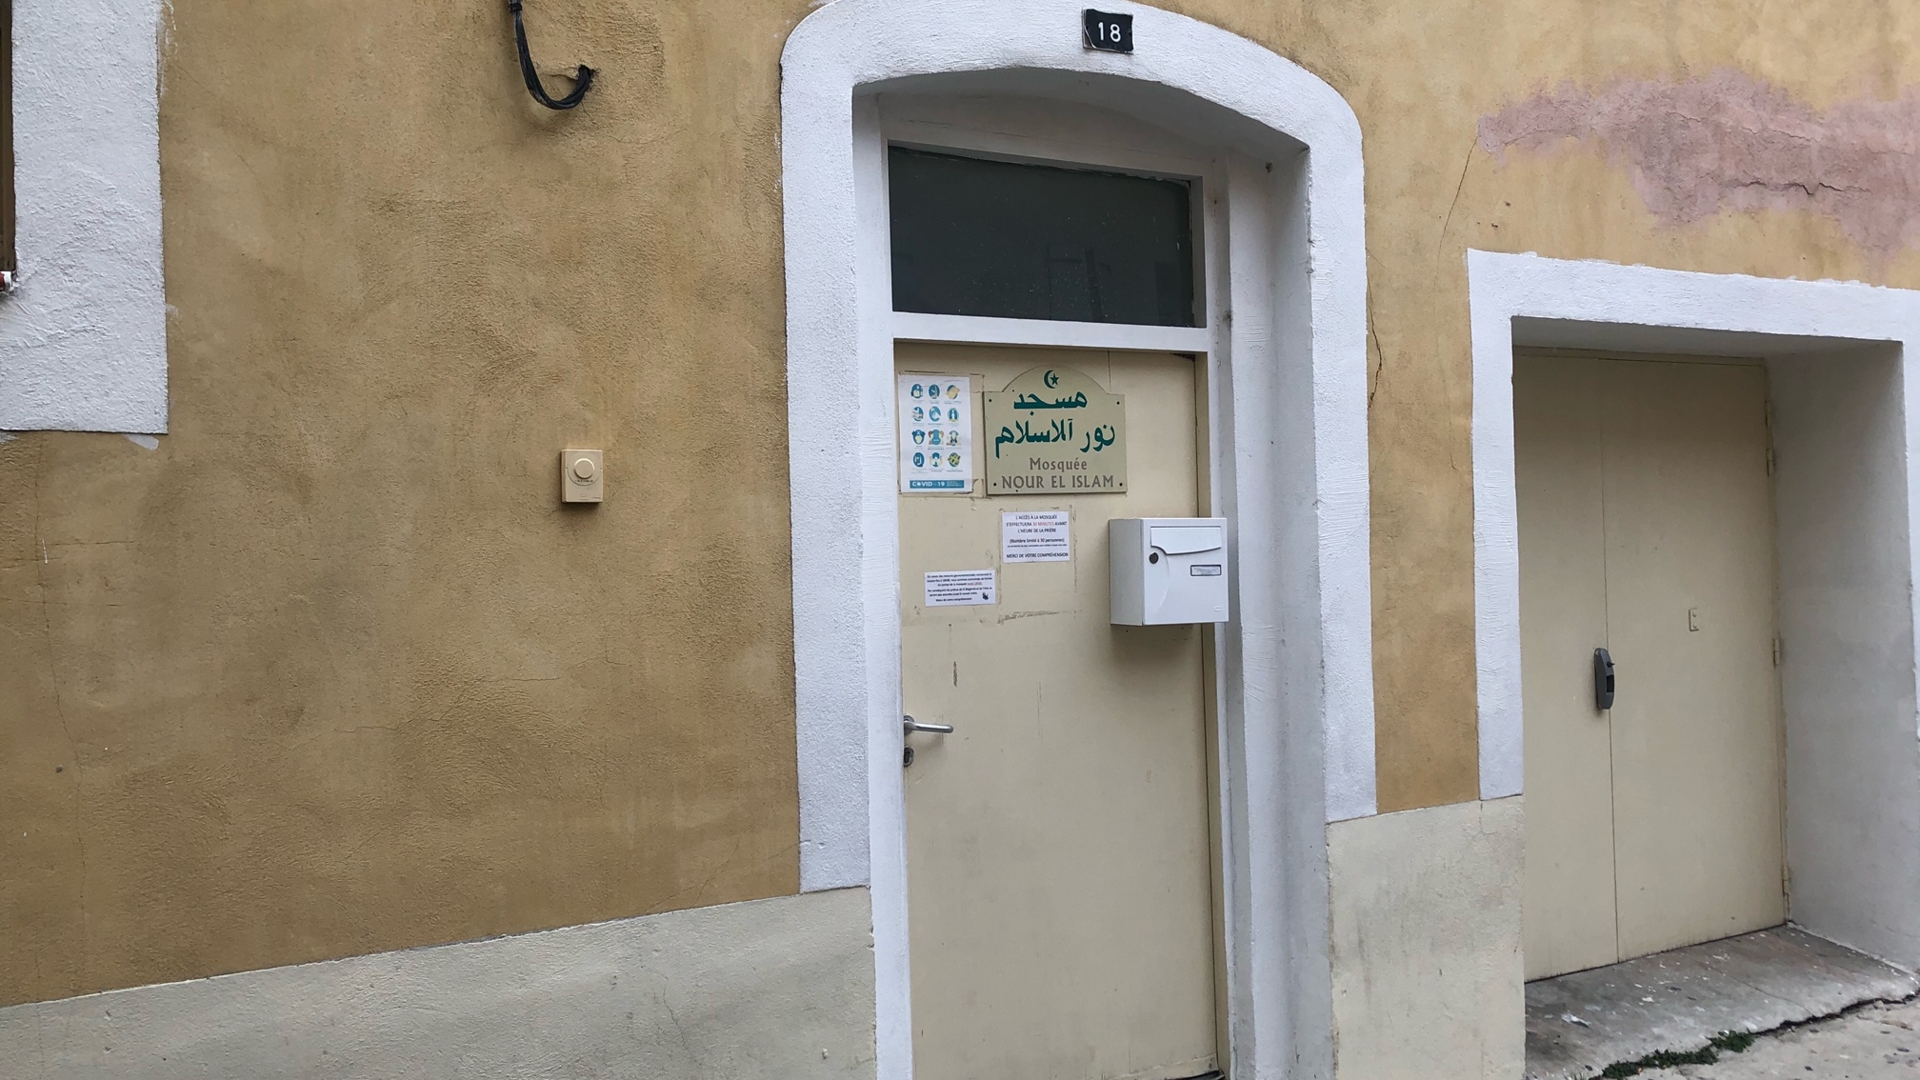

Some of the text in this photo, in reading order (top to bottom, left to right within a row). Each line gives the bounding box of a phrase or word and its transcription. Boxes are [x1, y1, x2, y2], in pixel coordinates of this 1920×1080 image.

[1098, 22, 1121, 42] 18
[1014, 391, 1088, 416] مسجد
[1080, 424, 1115, 453] نور
[1029, 457, 1088, 472] Mosquée
[1002, 474, 1114, 489] NOUR EL ISLAM
